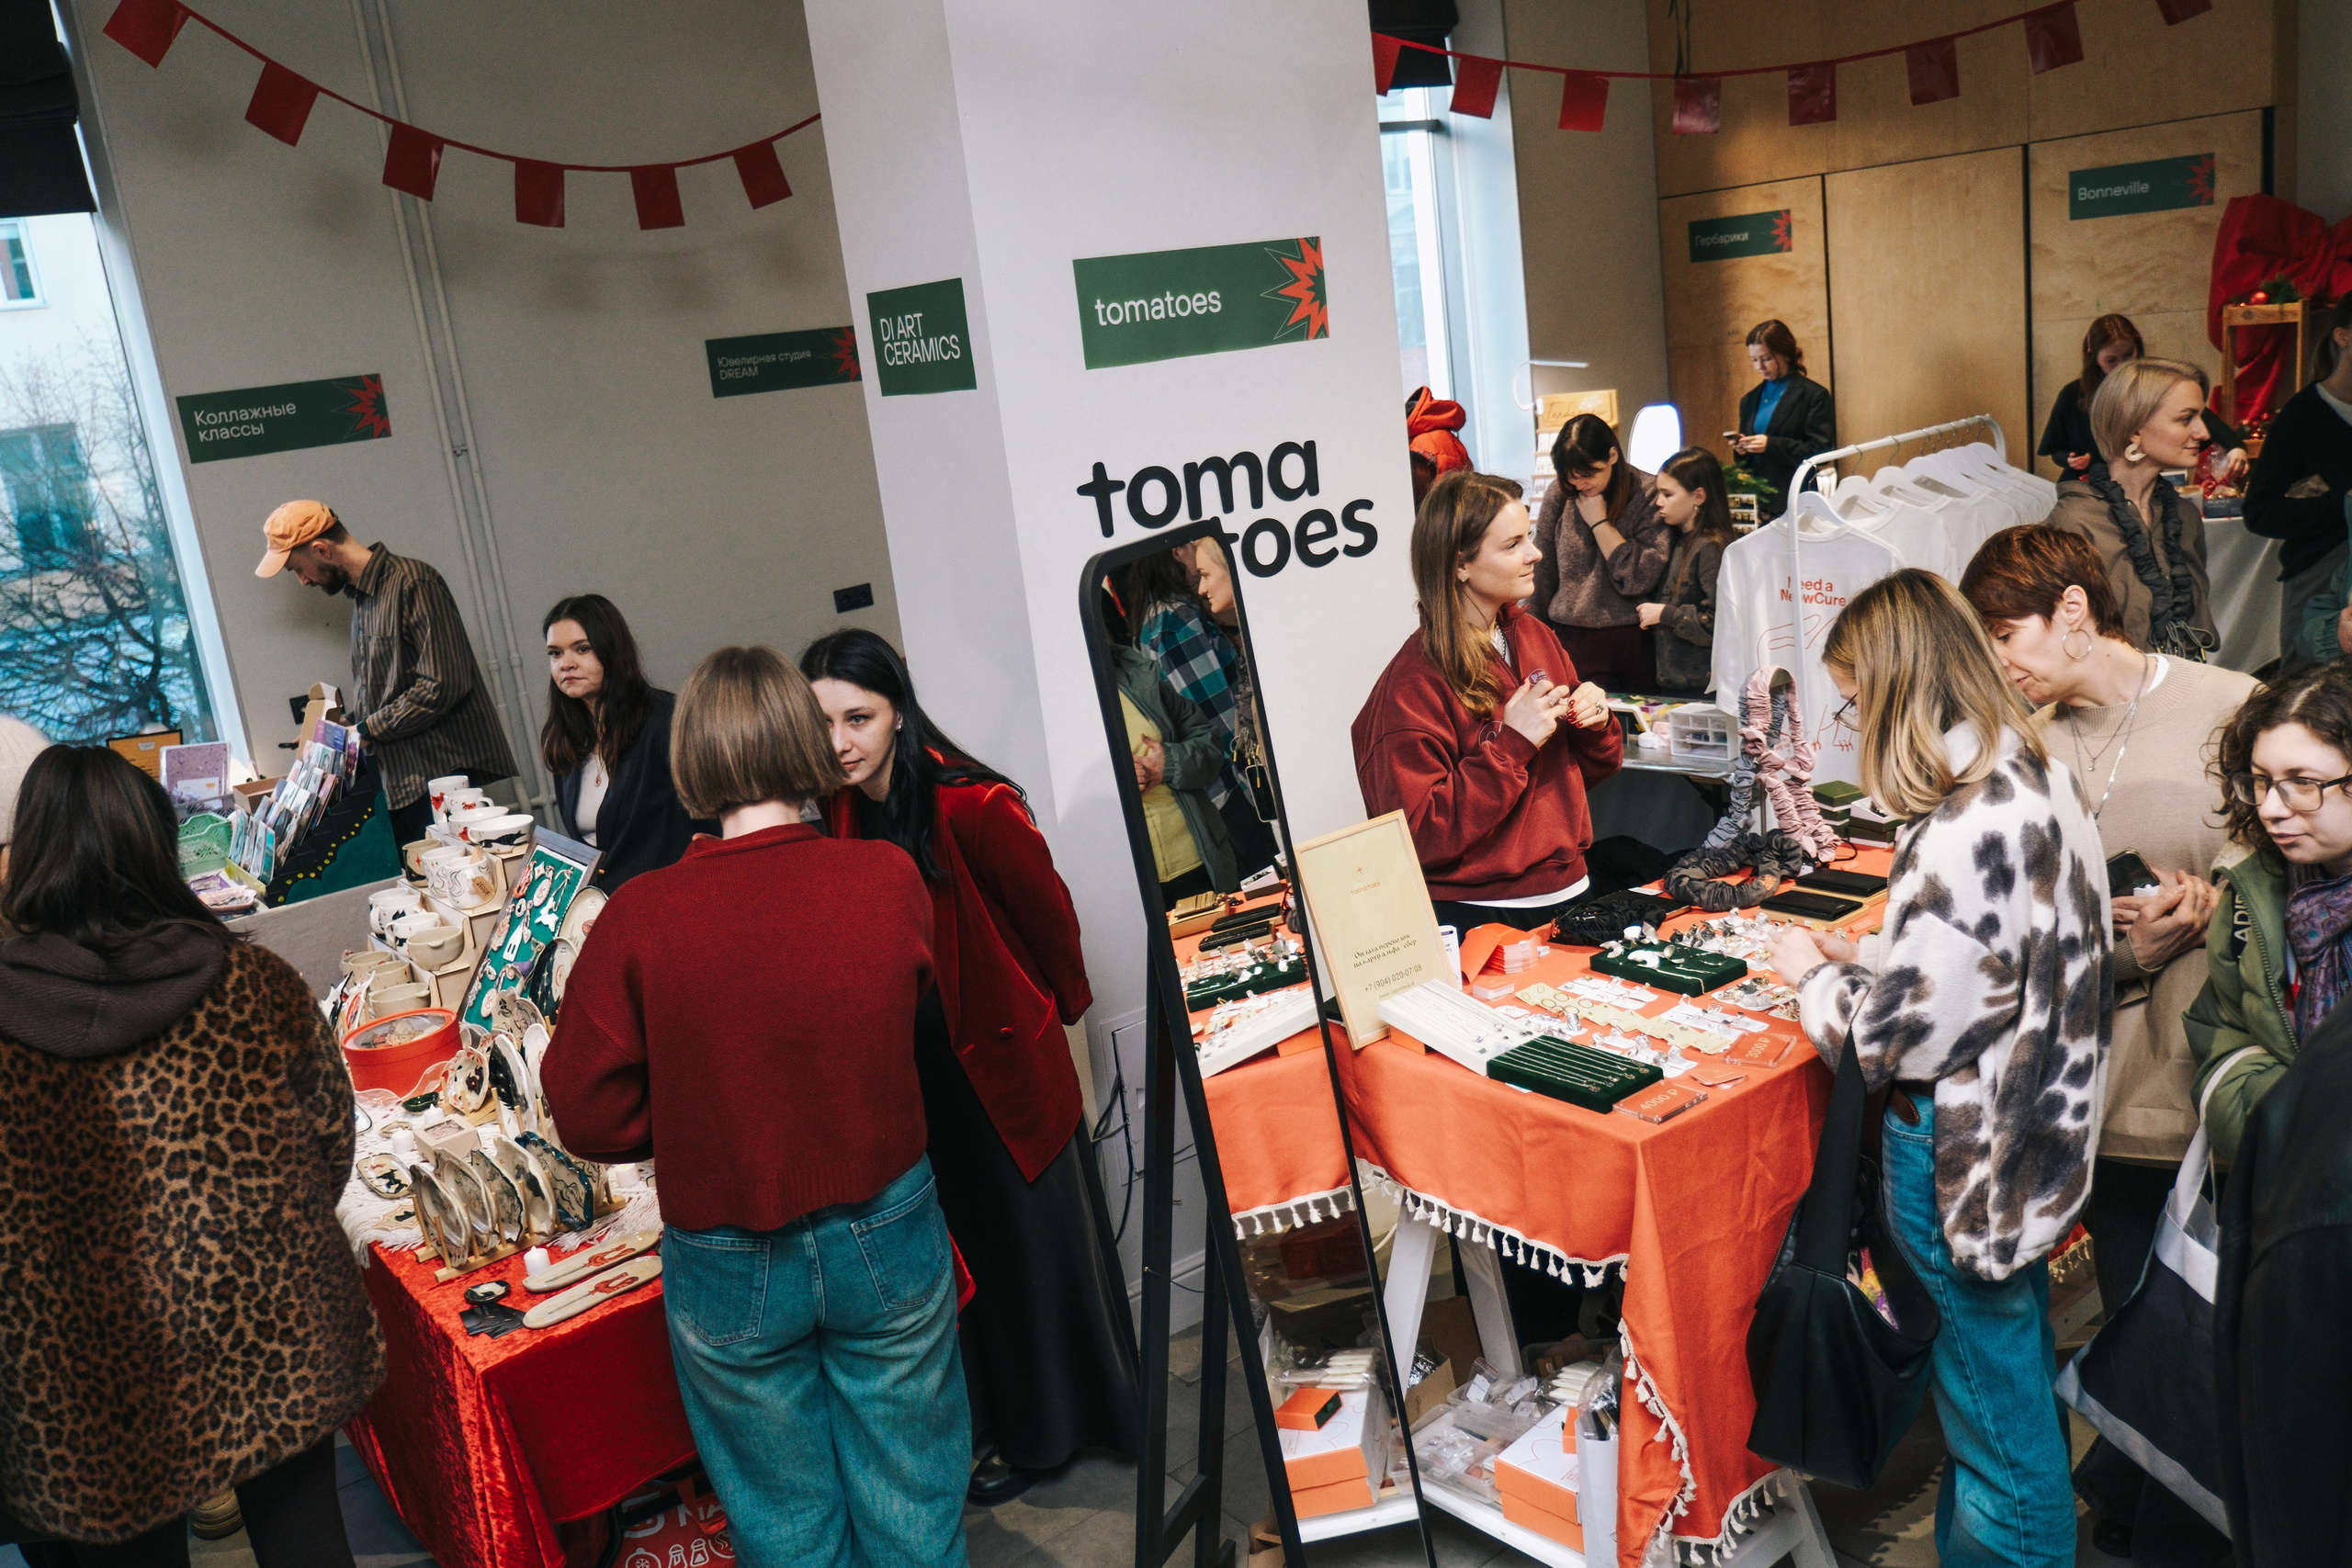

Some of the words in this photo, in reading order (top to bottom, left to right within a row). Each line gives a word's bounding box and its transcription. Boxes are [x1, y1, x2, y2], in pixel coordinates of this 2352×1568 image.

[2078, 182, 2149, 201] Bonneville
[1695, 231, 1749, 248] Гербарики
[1094, 290, 1222, 326] tomatoes
[718, 355, 776, 368] Ювелирная
[778, 350, 811, 364] студия
[884, 334, 961, 367] CERAMICS
[719, 367, 759, 380] DREAM
[194, 402, 297, 426] Коллажные
[198, 422, 265, 443] классы
[1077, 439, 1320, 538] toma
[1825, 581, 1834, 592] a
[1351, 881, 1380, 895] tomatoes
[1364, 983, 1373, 992] +7
[1374, 976, 1392, 990] (904)
[1391, 964, 1422, 982] 020-07-08
[1746, 1042, 1767, 1058] 3000
[1639, 1093, 1670, 1111] 4000
